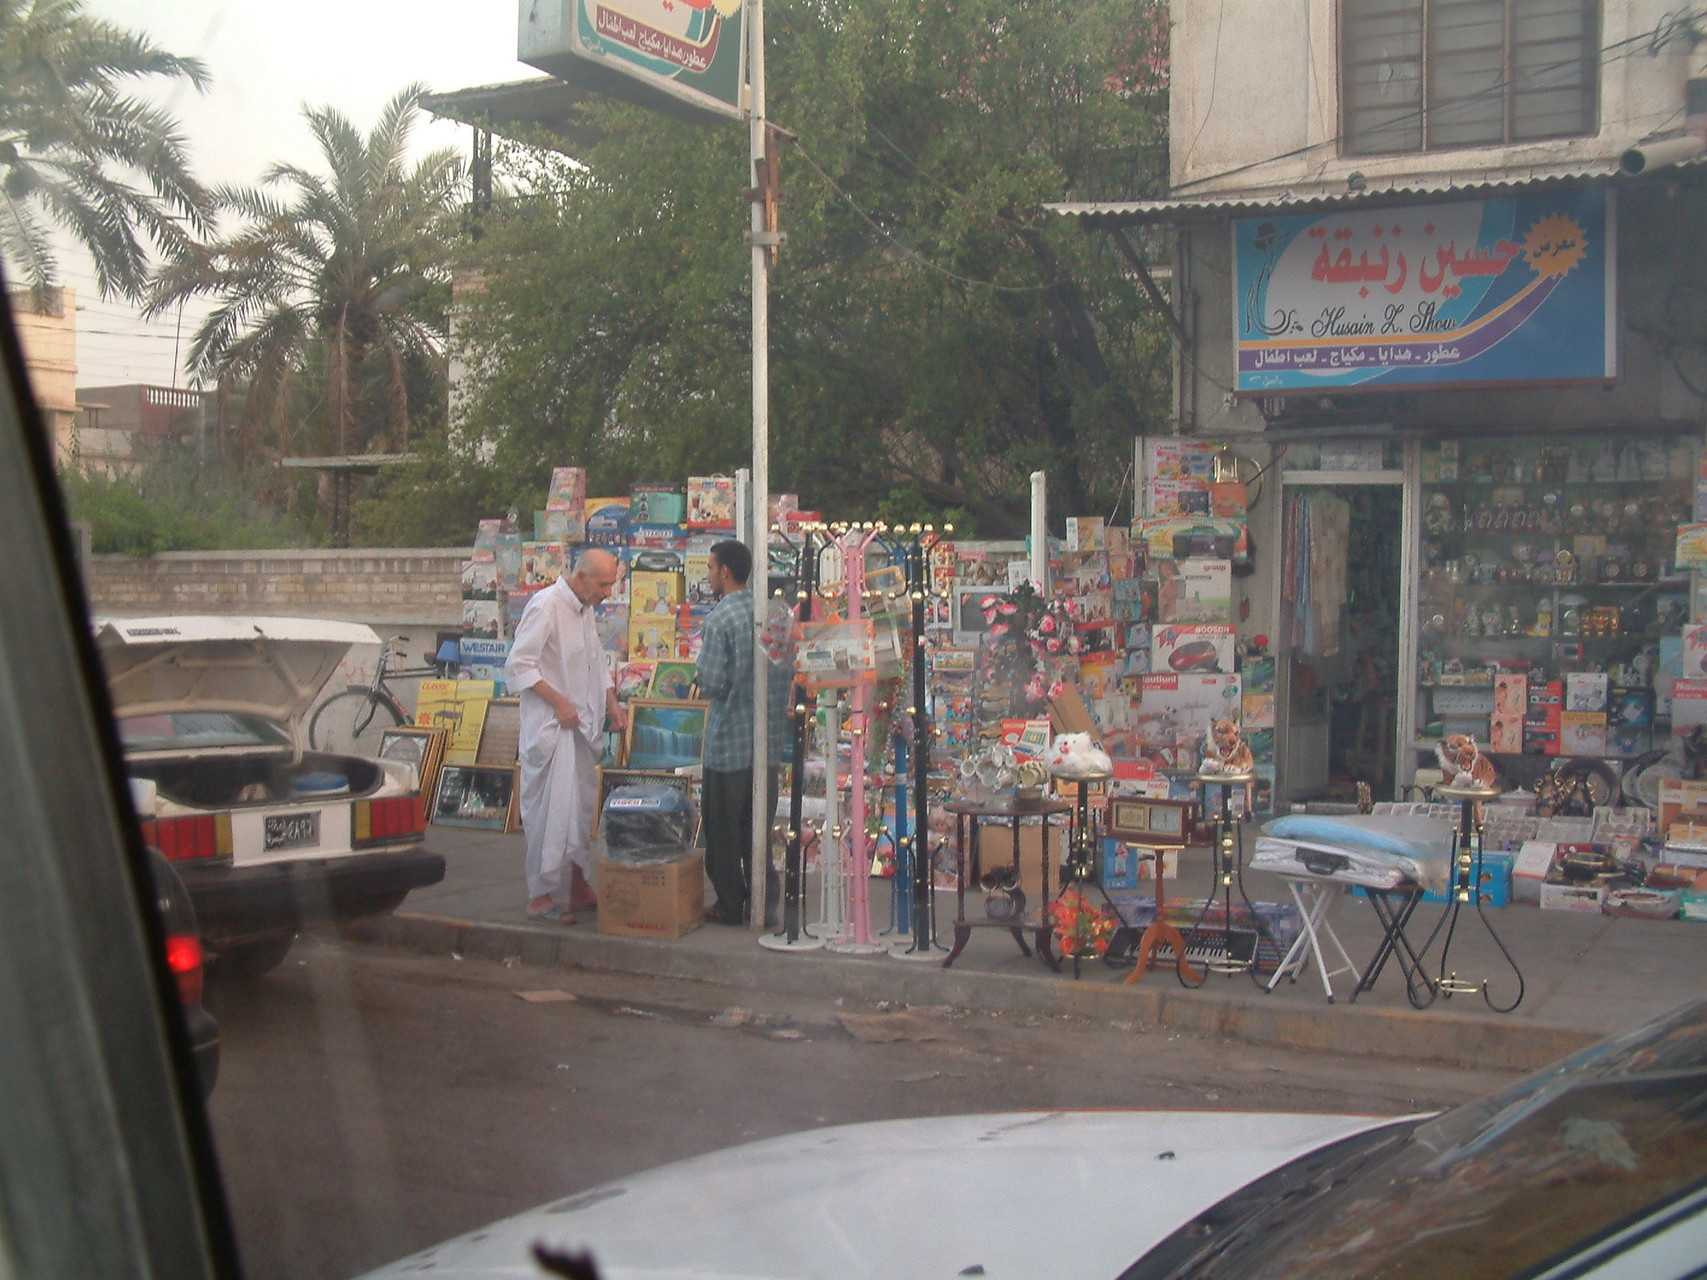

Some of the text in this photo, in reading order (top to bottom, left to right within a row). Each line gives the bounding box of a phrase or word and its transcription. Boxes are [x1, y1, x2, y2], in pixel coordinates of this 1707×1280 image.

[1308, 221, 1521, 299] حسين زنبقة
[1311, 306, 1376, 338] Husain
[1409, 300, 1457, 333] Show
[1254, 344, 1461, 369] عطور هدايا مكياج لعب اطفال
[462, 641, 506, 653] WESTAIR
